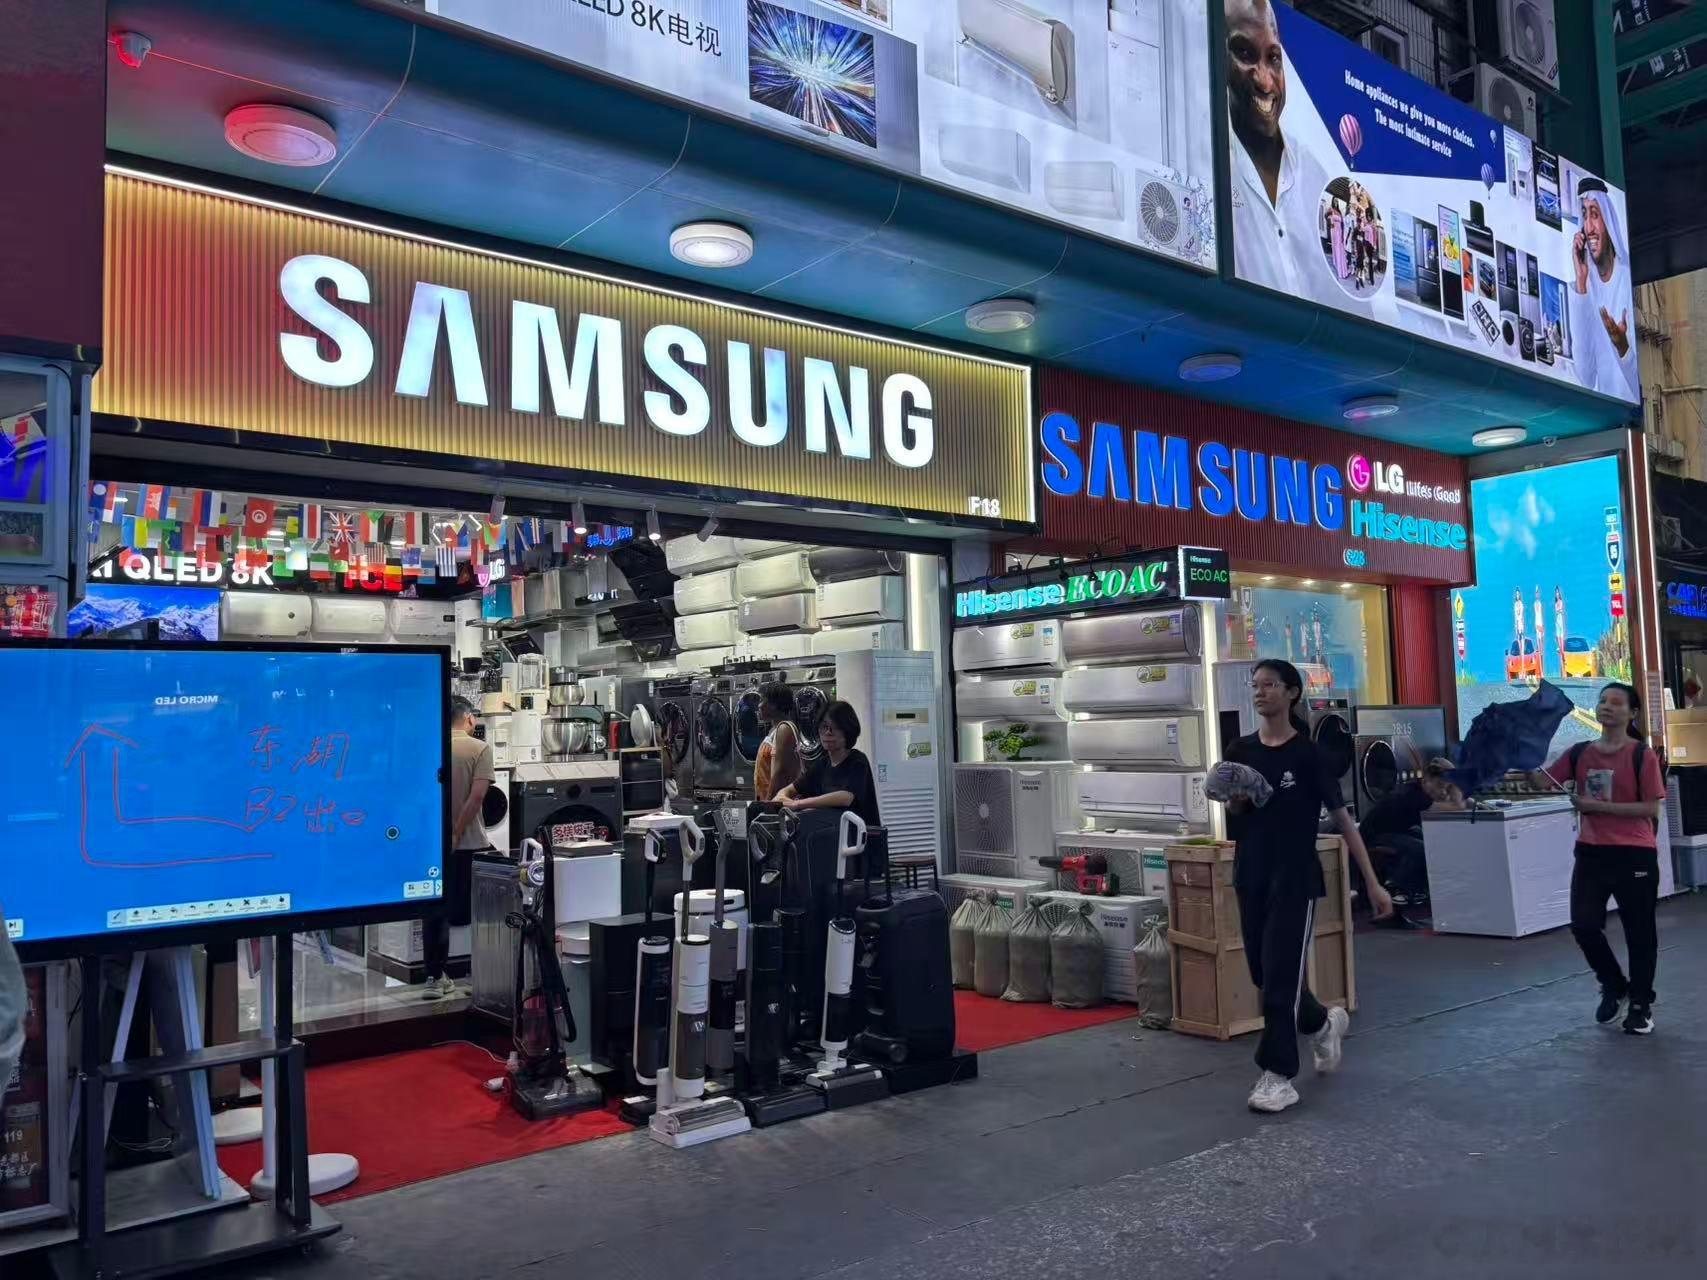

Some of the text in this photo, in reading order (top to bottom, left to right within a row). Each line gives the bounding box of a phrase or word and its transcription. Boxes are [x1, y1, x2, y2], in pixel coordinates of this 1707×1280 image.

[1344, 69, 1365, 92] Home
[1365, 84, 1399, 109] appliances
[1399, 101, 1409, 114] we
[1409, 105, 1423, 122] give
[1423, 113, 1436, 128] you
[1436, 120, 1452, 136] more
[1375, 108, 1388, 126] The
[1388, 118, 1405, 134] most
[1431, 140, 1452, 157] service
[280, 253, 936, 470] SAMSUNG
[1039, 410, 1346, 531] SAMSUNG
[1373, 461, 1405, 494] LG
[968, 496, 1000, 517] F18
[1351, 499, 1468, 551] Hisense
[123, 554, 223, 583] QLED
[1190, 568, 1229, 583] ECO AC
[956, 583, 1064, 618] Hisense
